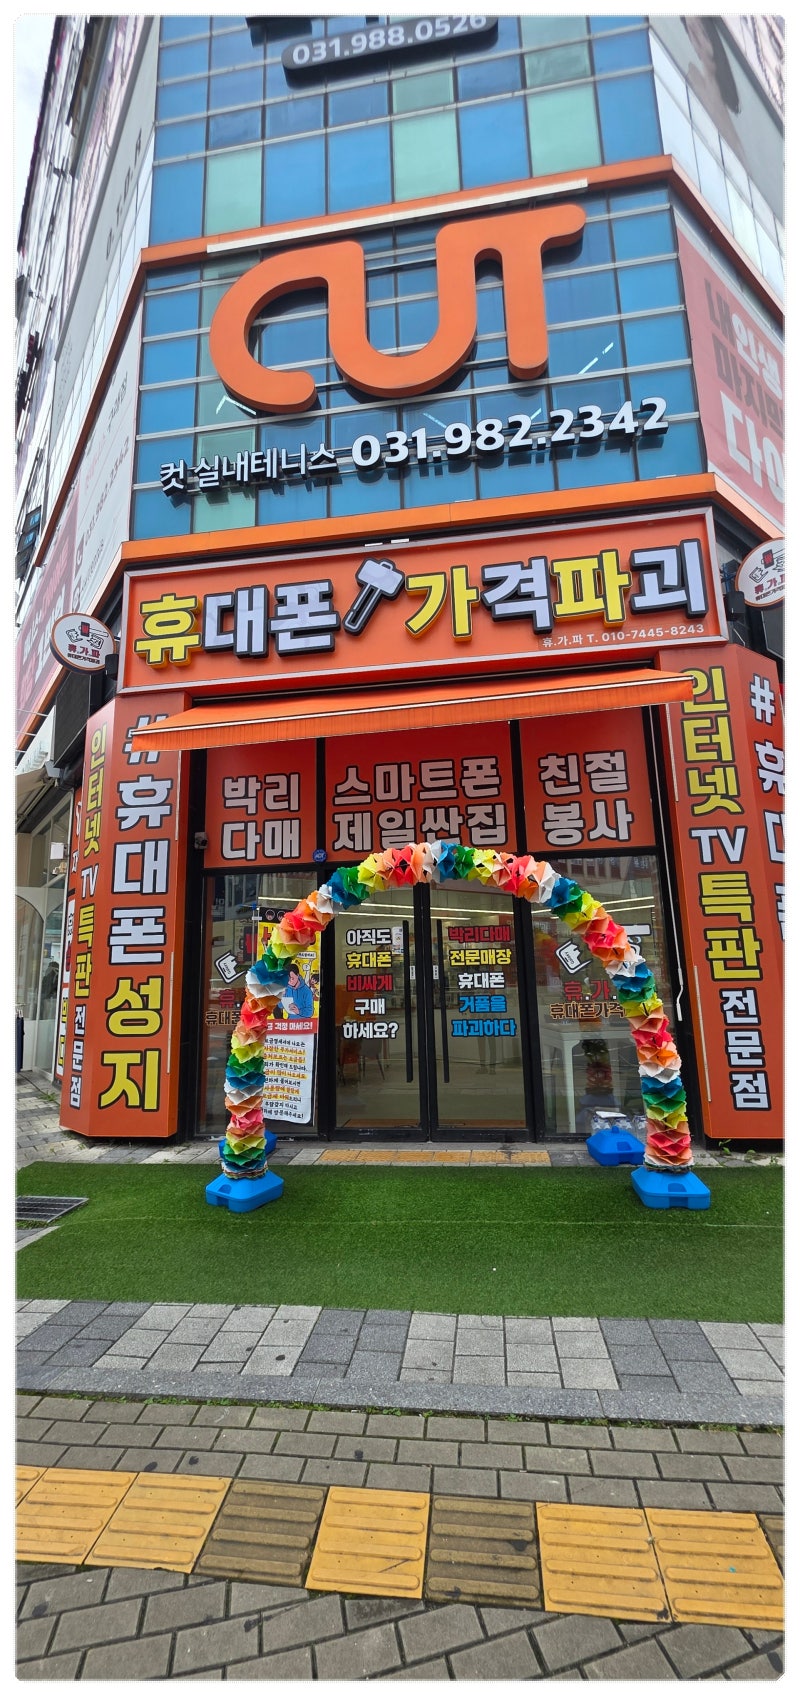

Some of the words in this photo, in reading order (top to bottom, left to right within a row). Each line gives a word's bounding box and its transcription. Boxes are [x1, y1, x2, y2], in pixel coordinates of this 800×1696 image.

[293, 16, 486, 65] 031.988.0526
[209, 204, 587, 414] CUT
[160, 460, 185, 494] 컷
[194, 442, 338, 490] 실내테니스
[352, 397, 669, 467] 031.982.2342
[135, 579, 340, 668] 휴대폰
[405, 539, 707, 641] 가격파괴
[542, 633, 583, 648] 휴.가.파
[587, 633, 598, 645] T.
[602, 623, 705, 643] 010-7445-8243
[681, 666, 744, 815] 인터넷
[83, 721, 107, 859] 인터넷
[223, 772, 300, 816] 박리
[333, 755, 500, 806] 스마트폰
[539, 751, 630, 797] 친절
[221, 818, 301, 861] 다매
[332, 803, 508, 853] 제일싼집
[543, 798, 634, 847] 봉사
[690, 827, 747, 865] TV
[81, 862, 99, 899] TV
[346, 927, 392, 946] 아직도
[448, 925, 512, 943] 박리다매
[698, 872, 763, 982] 특판
[74, 903, 95, 998] 특판
[346, 951, 392, 969] 휴대폰
[449, 949, 512, 966] 전문매장
[347, 974, 393, 992] 비싸게
[458, 972, 505, 990] 휴대폰
[354, 998, 386, 1015] 구매
[458, 994, 507, 1013] 거품을
[342, 1021, 399, 1039] 하세요?
[451, 1018, 517, 1037] 파괴하다
[720, 987, 771, 1111] 전문점
[69, 1004, 87, 1110] 전문점
